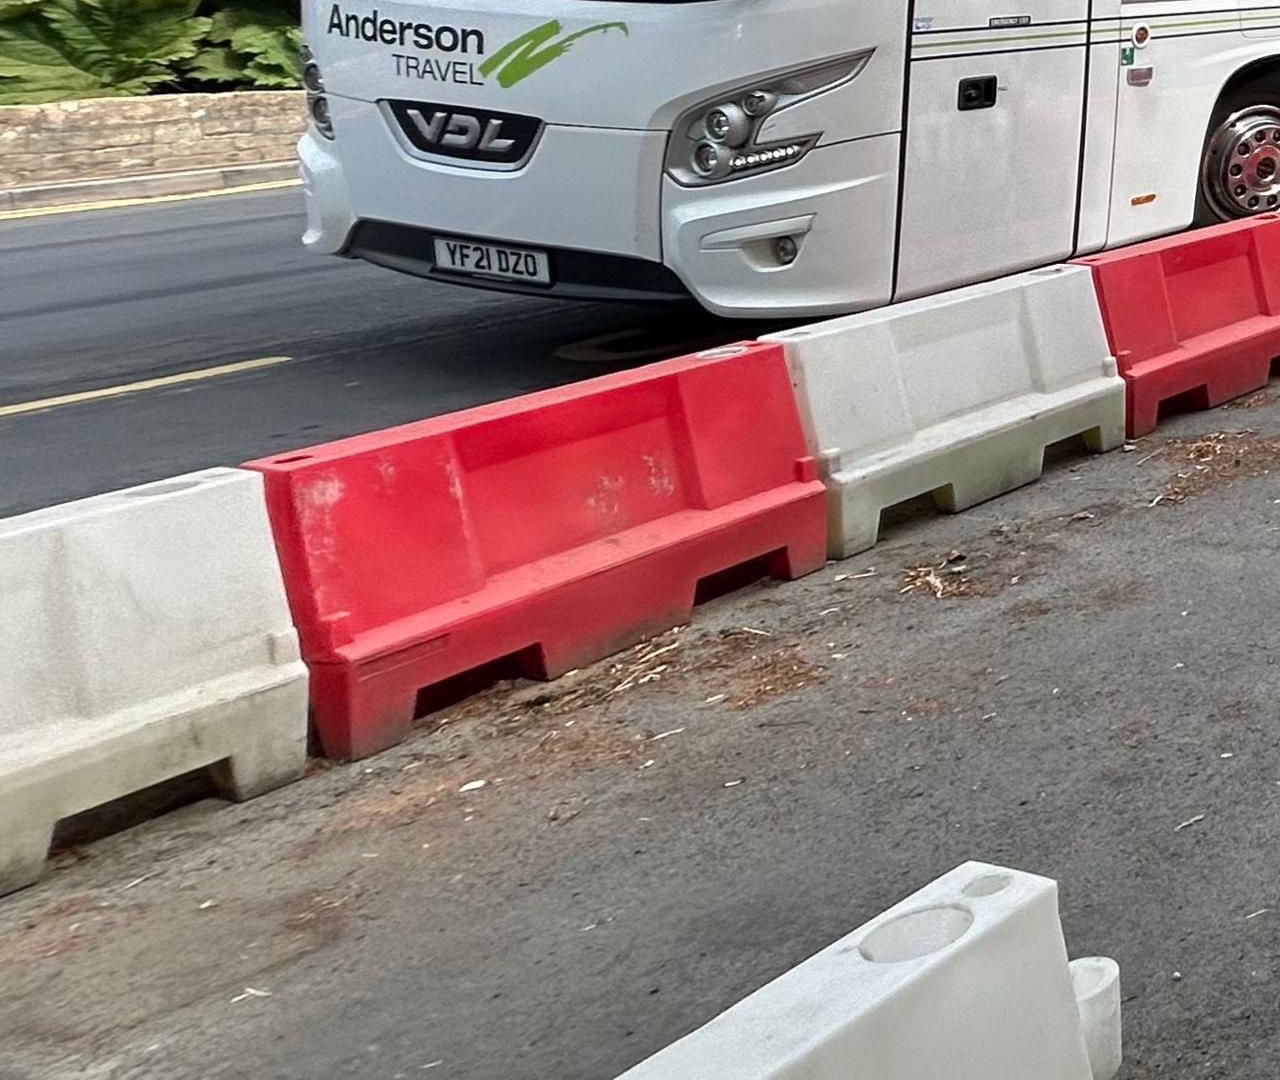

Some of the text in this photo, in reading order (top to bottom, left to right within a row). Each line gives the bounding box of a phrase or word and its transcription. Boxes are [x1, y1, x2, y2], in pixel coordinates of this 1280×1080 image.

[327, 3, 485, 55] Anderson
[392, 53, 485, 86] TRAVEL
[406, 109, 516, 152] VDL
[445, 241, 538, 277] YF21 DZO
